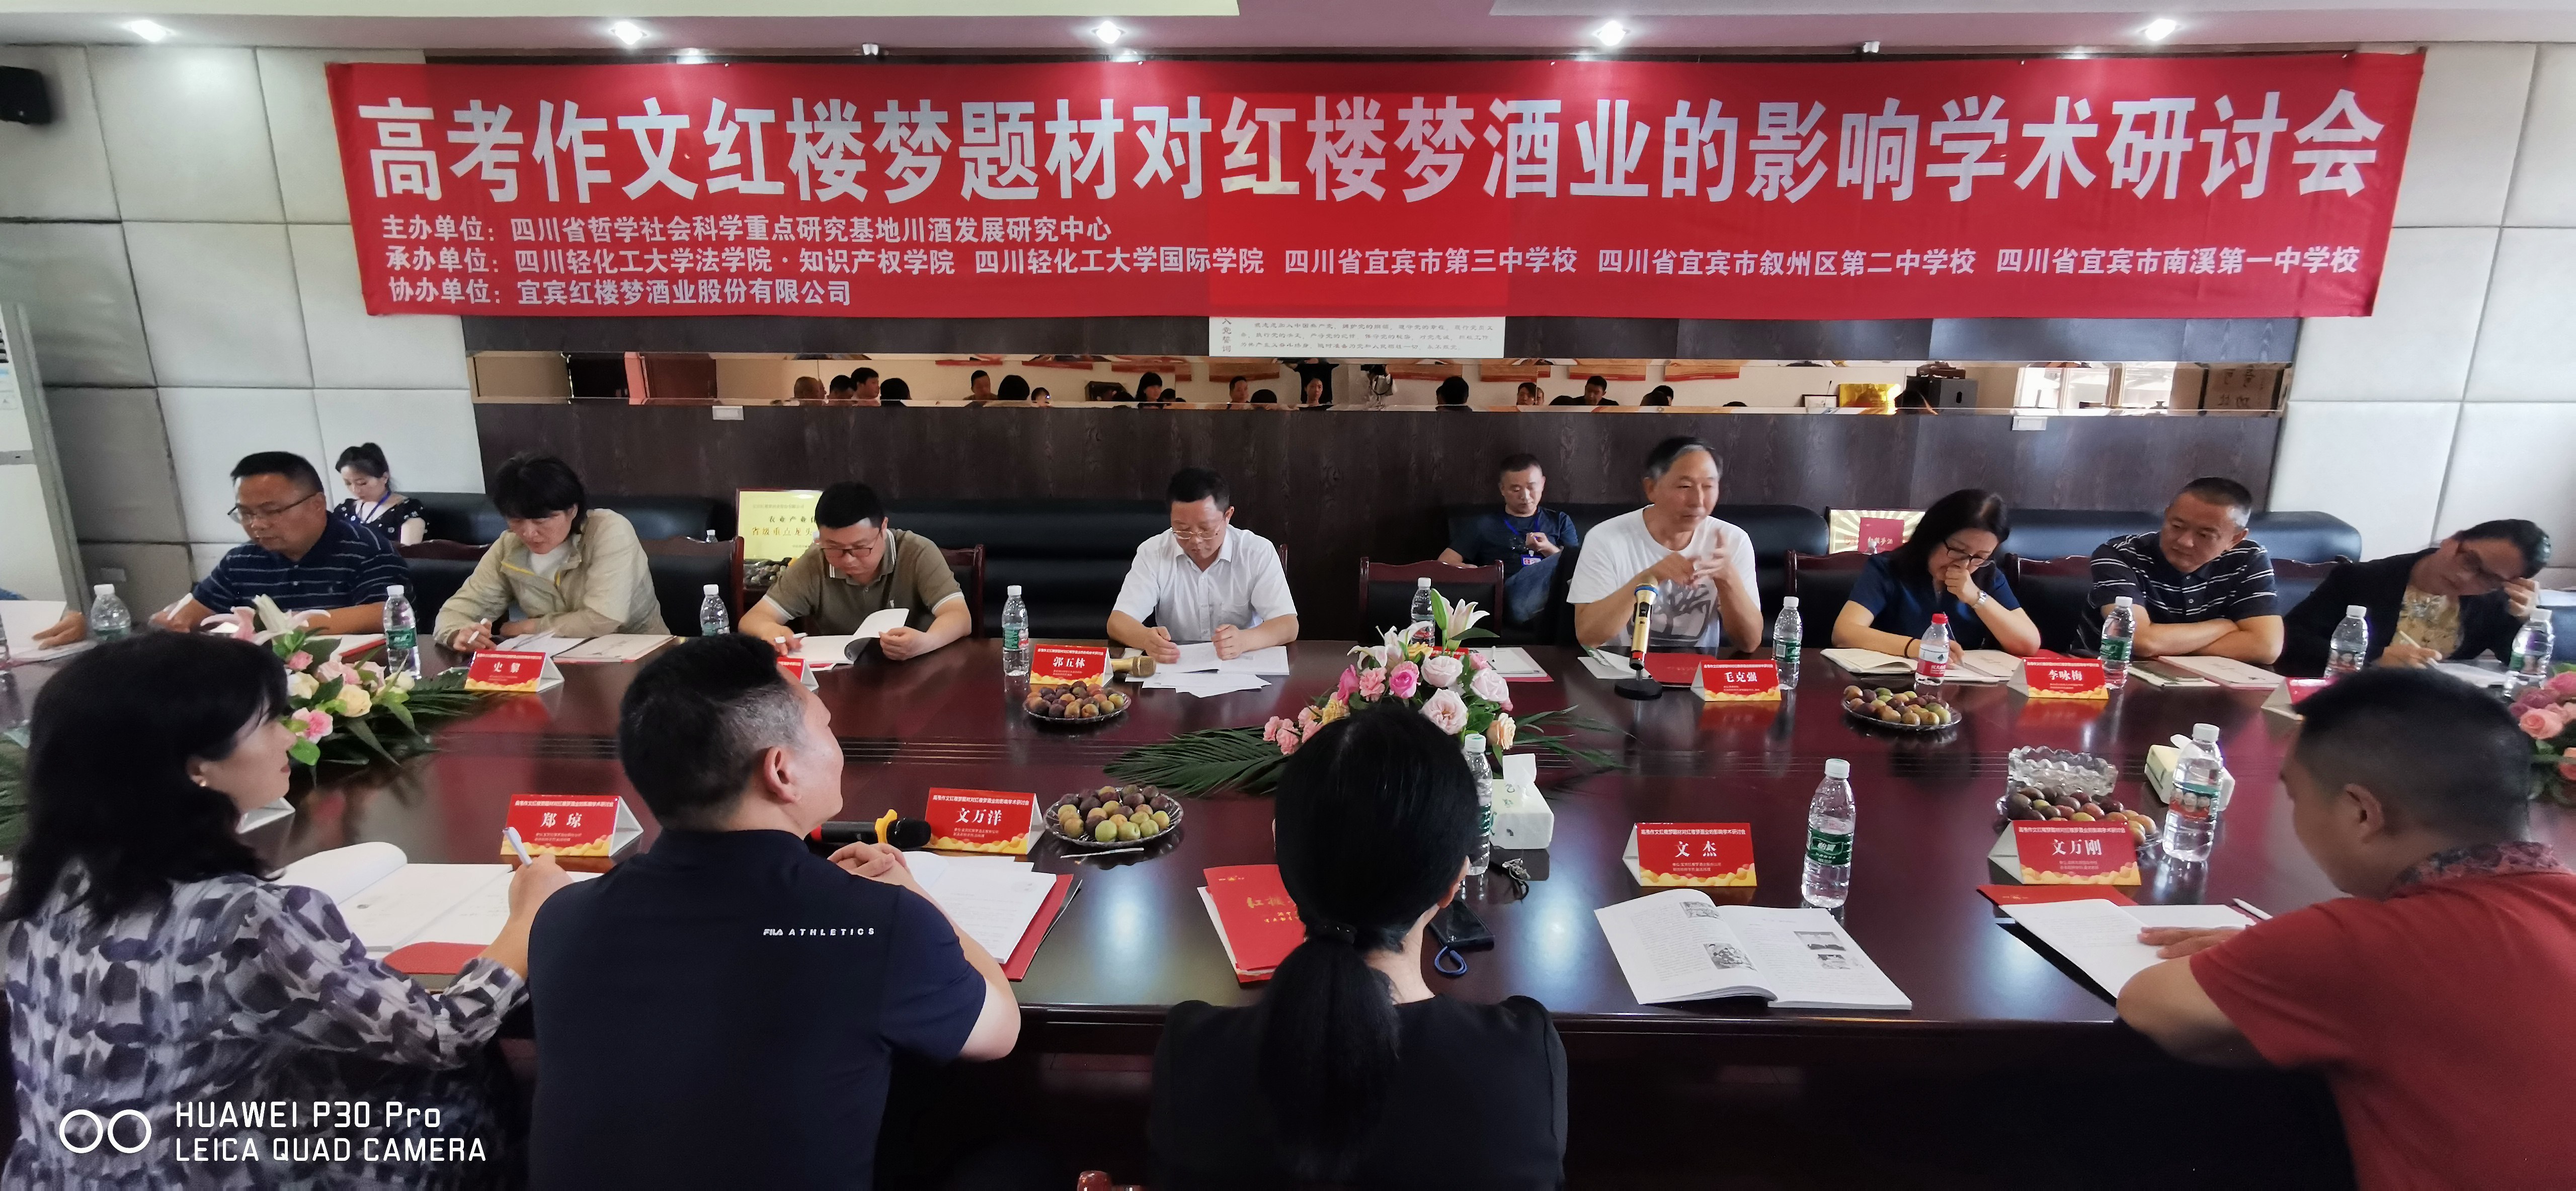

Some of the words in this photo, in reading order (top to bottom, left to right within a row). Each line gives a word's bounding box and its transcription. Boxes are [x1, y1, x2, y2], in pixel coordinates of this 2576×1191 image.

[358, 89, 2384, 203] 高考作文红楼梦题材对红楼梦酒业的影响学术研讨会
[511, 215, 1112, 243] 四川省哲学社会科学重点研究基地川酒发展研究中心
[975, 246, 1264, 275] 四川轻化工大学国际学院
[1285, 246, 1578, 275] 四川省宜宾市第三中学校
[1598, 248, 1976, 277] 四川省宜宾市叙州区第二中学校
[1997, 246, 2361, 275] 四川省宜宾市南溪第一中学校
[518, 278, 851, 306] 宜宾红楼梦酒业股份有限公司
[1724, 671, 1758, 683] 毛克强
[2048, 669, 2083, 682] 李咏梅
[956, 807, 1002, 826] 文万洋
[2052, 838, 2102, 856] 文万刚
[788, 928, 875, 936] ATHLETICS
